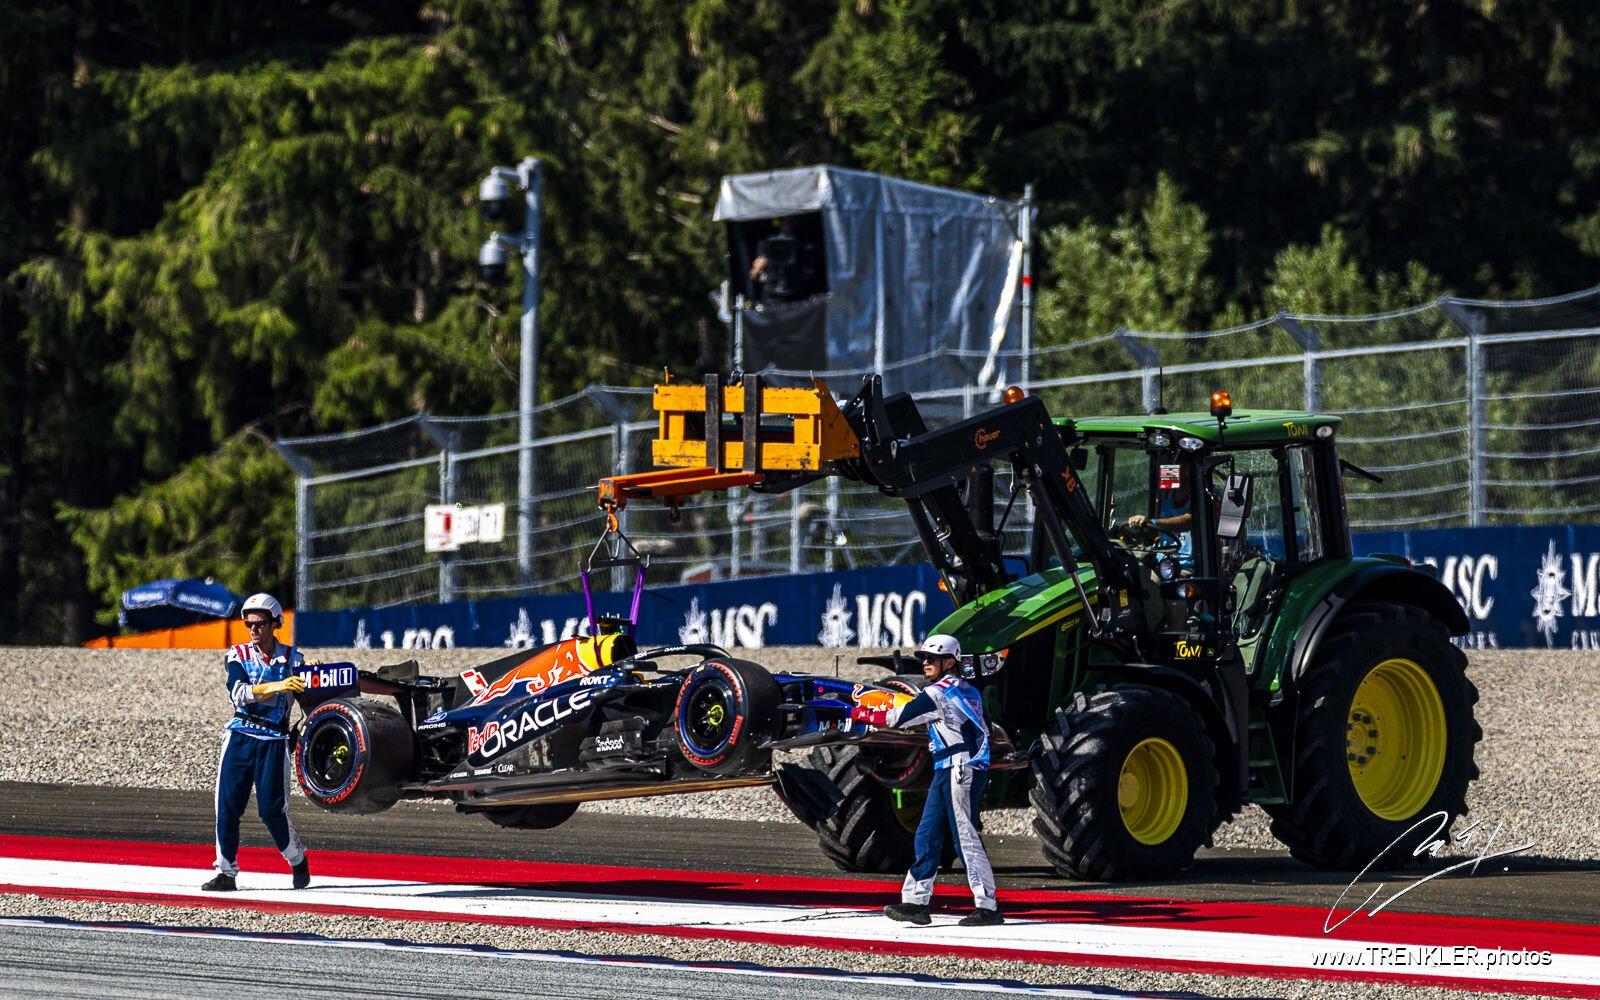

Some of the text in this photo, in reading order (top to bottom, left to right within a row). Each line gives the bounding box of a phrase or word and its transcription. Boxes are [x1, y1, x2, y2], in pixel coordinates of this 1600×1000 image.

[1283, 421, 1308, 438] TONI
[854, 589, 927, 648] MSC
[1173, 640, 1203, 658] TONI
[300, 668, 338, 689] Mobil
[580, 675, 612, 686] ROKT
[418, 722, 446, 731] RACING
[480, 688, 593, 758] ORACLE
